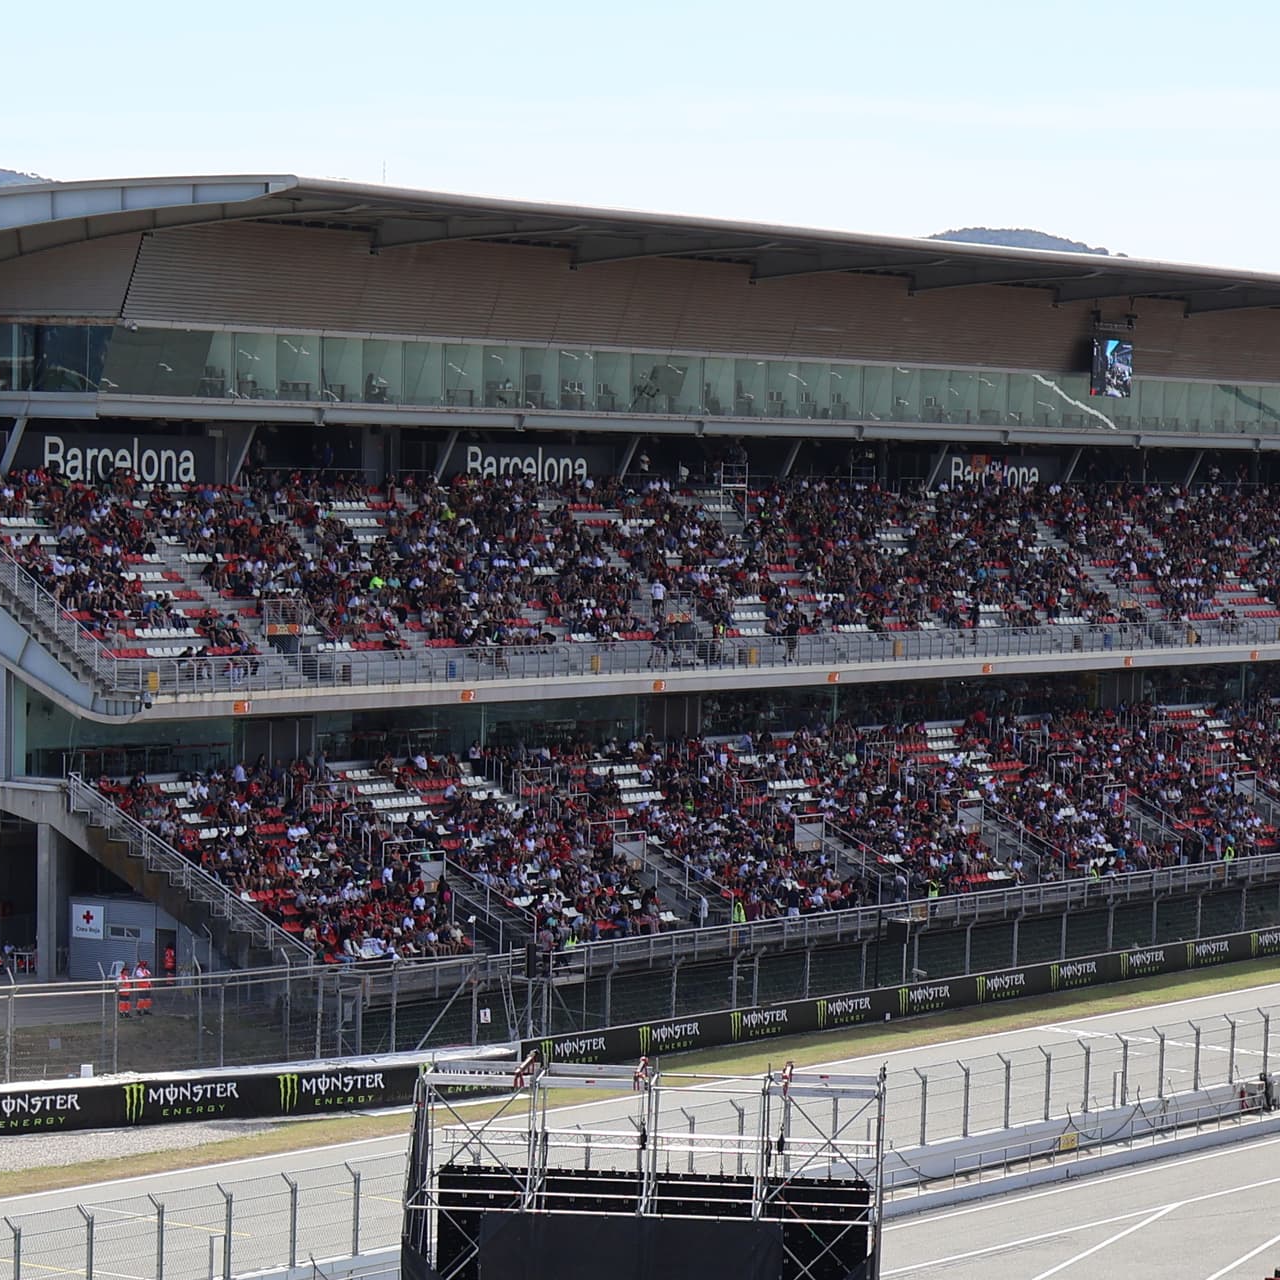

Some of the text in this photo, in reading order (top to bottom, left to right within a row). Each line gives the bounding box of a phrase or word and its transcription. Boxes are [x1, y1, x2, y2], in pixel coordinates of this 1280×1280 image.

[43, 435, 196, 482] Barcelona
[1130, 950, 1165, 968] MONSTER
[1195, 940, 1229, 958] MONSTER
[1061, 961, 1097, 980] MONSTER
[987, 973, 1025, 991] MONSTER
[911, 985, 950, 1005] MONSTER
[831, 996, 871, 1017] MONSTER
[742, 1009, 788, 1029] MONSTER
[651, 1022, 700, 1043] MONSTER
[554, 1036, 607, 1059] MONSTER
[149, 1082, 239, 1107] MONSTER
[301, 1072, 385, 1098] MONSTER
[162, 1103, 226, 1117] ENERGY
[315, 1094, 375, 1107] ENERGY
